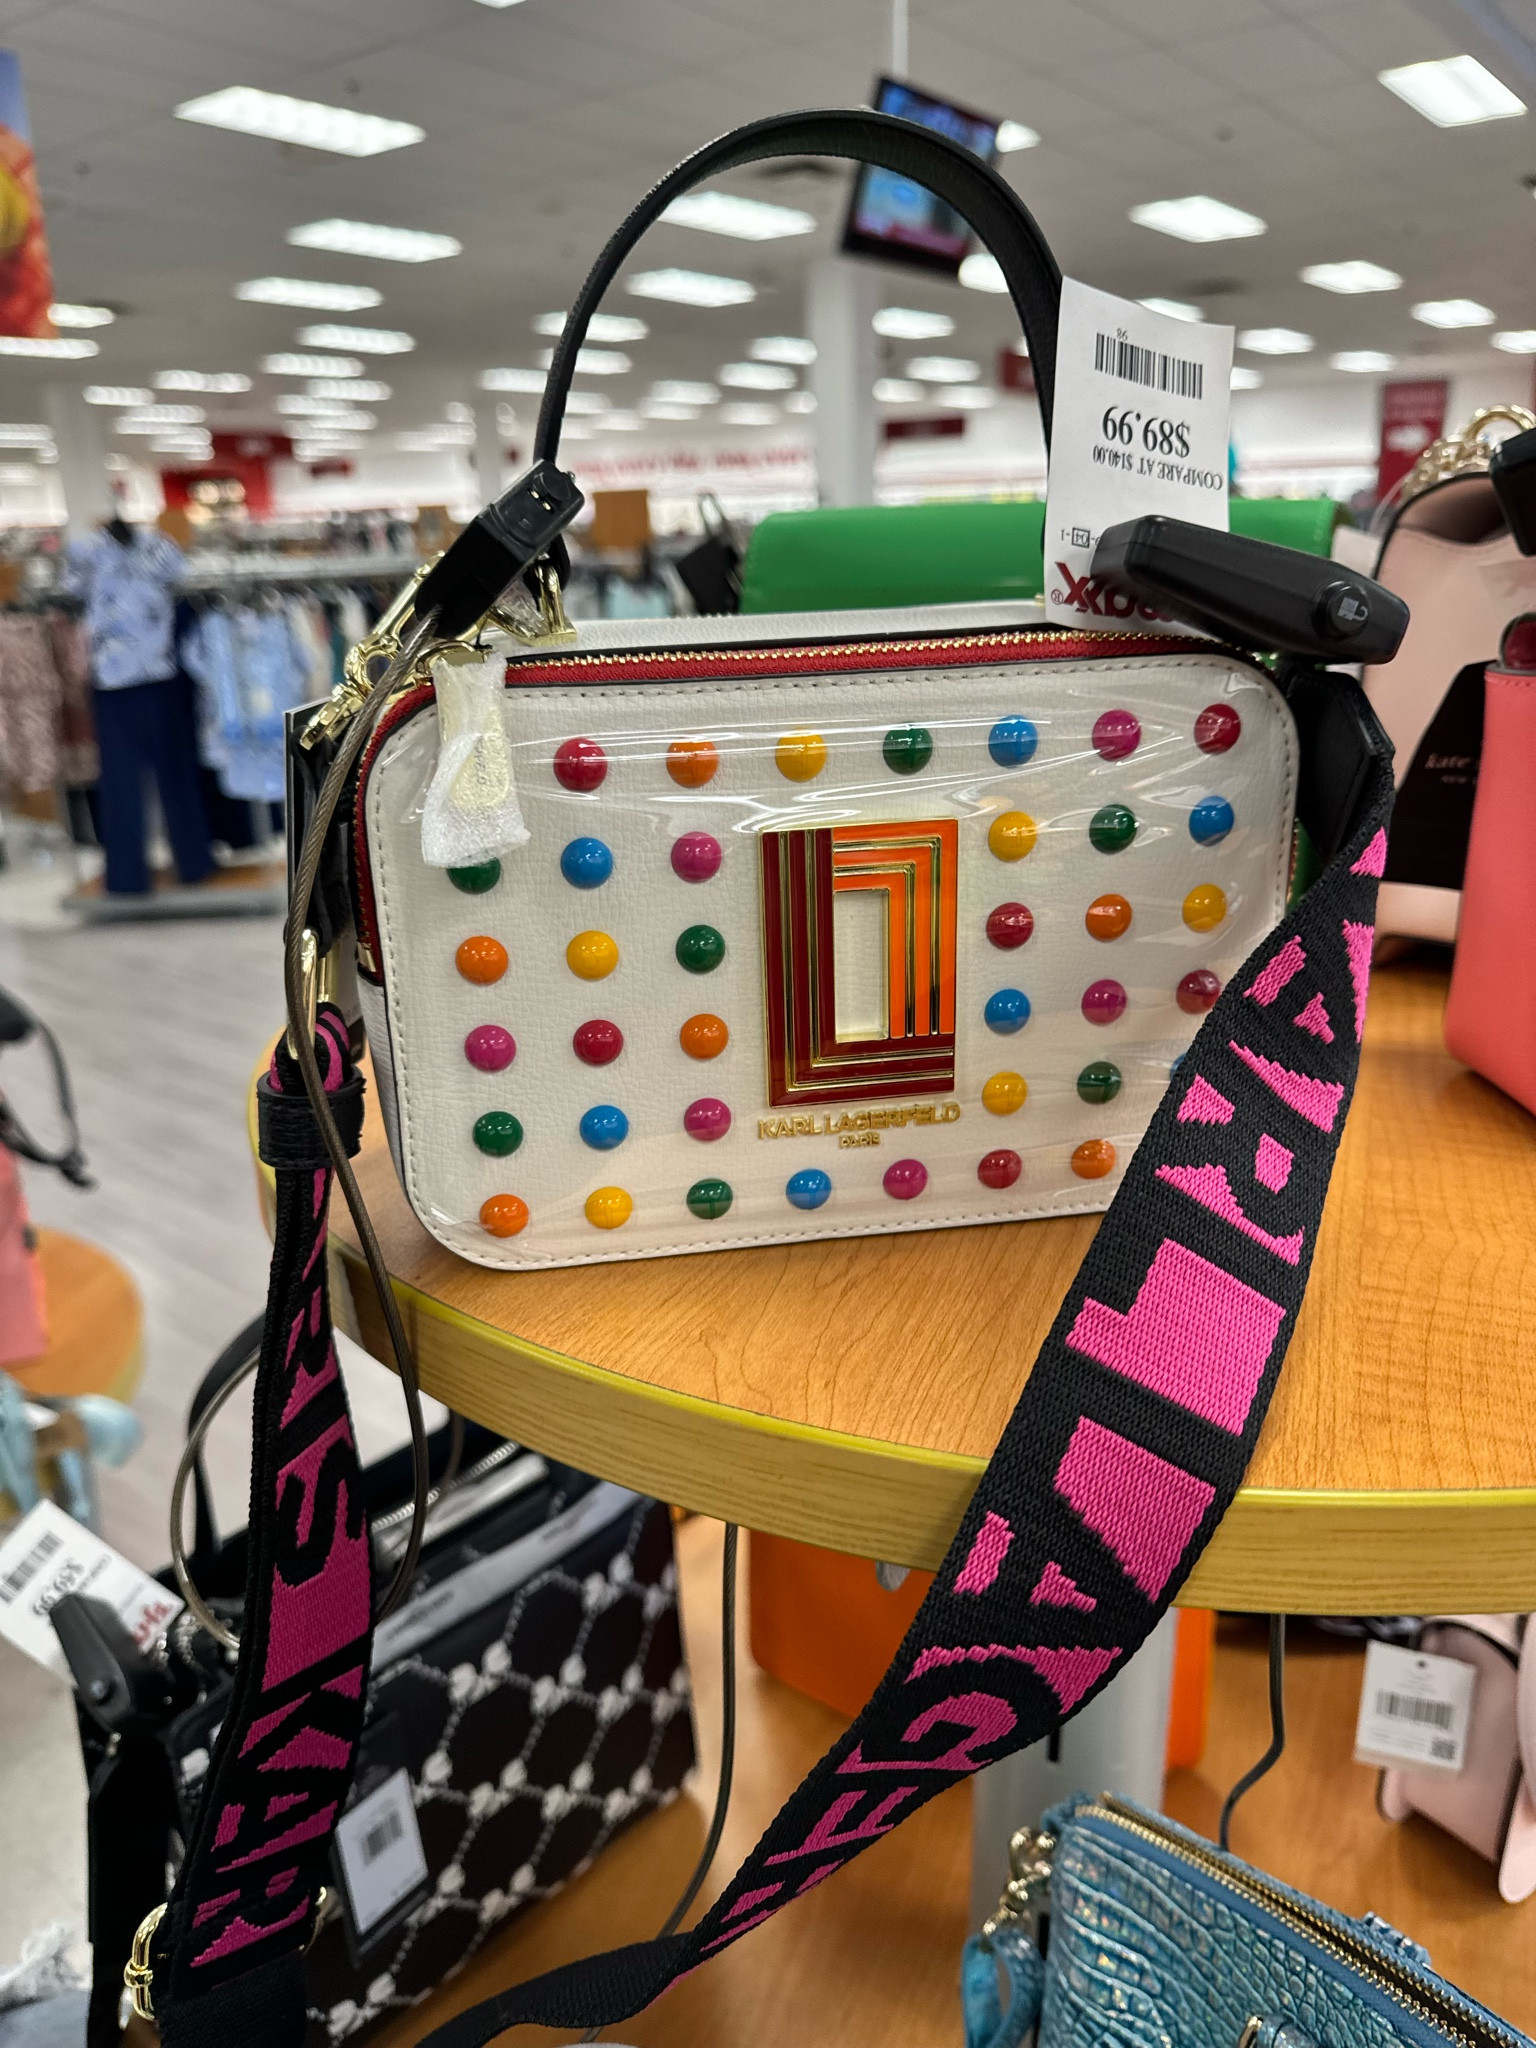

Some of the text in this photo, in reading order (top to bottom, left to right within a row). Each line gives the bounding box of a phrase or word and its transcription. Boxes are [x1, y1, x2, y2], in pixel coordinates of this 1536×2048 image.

[1115, 327, 1129, 341] 98
[1102, 406, 1191, 459] $89.99
[1092, 445, 1223, 490] COMPARE AT $140.00
[758, 1101, 962, 1140] KARL LAGERFELD
[839, 1132, 881, 1149] PARIS
